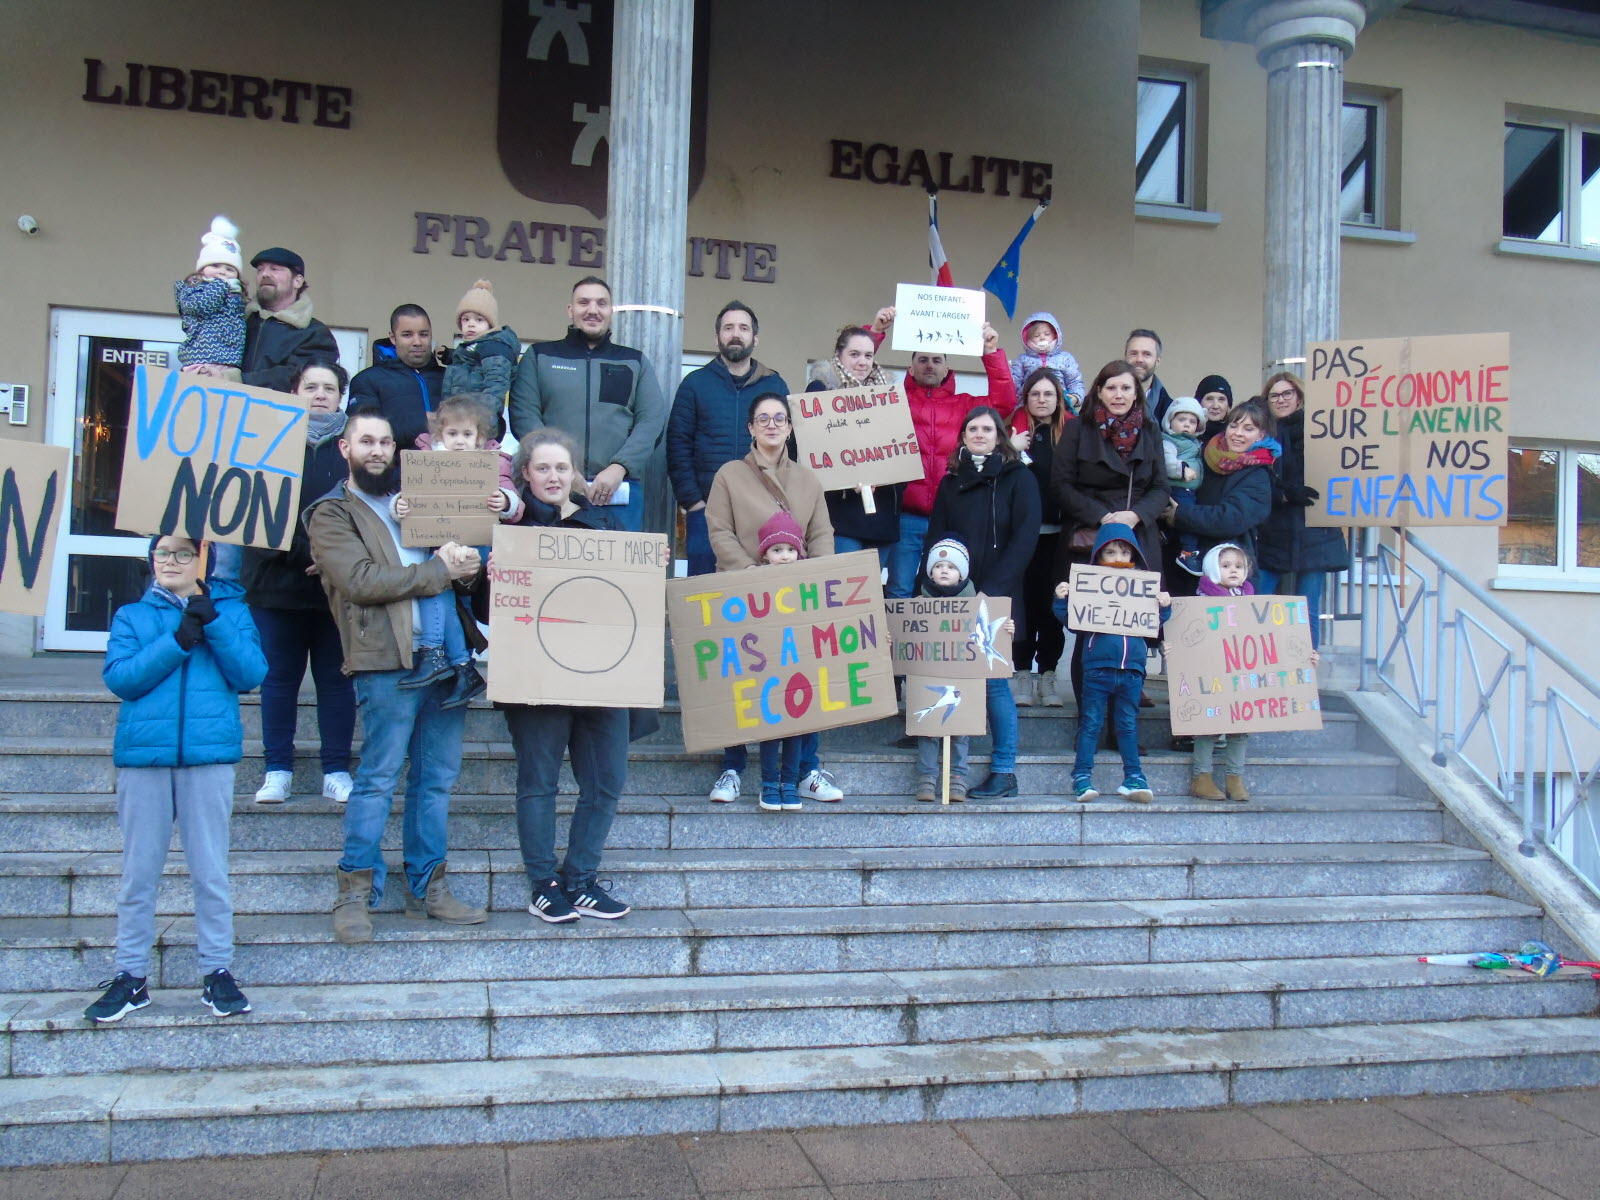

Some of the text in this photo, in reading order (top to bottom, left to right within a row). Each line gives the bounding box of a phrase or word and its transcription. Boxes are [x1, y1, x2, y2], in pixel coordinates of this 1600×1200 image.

[82, 57, 352, 129] LIBERTE
[830, 139, 1053, 200] EGALITE
[413, 212, 776, 283] FRATEITE
[917, 293, 933, 301] NOS
[911, 309, 970, 320] AVANT L'ARGENT
[102, 348, 168, 366] ENTREE
[1312, 346, 1368, 381] PAS
[800, 385, 899, 418] LA QUALITÉ
[136, 365, 305, 478] VOTEZ
[856, 418, 870, 428] que
[1311, 408, 1367, 439] SUR
[810, 433, 920, 469] LA QUANTITÉ
[1341, 440, 1490, 470] DE NOS
[160, 457, 292, 549] NON
[1327, 473, 1506, 521] ENFANTS
[538, 533, 664, 568] BUDGET MAIRIE
[491, 568, 532, 587] NOTRE
[1076, 572, 1157, 598] ECOLE
[494, 593, 530, 608] ECOLE
[686, 576, 871, 626] TOUCHEZ
[885, 600, 969, 615] NE TOUCHEZ
[1206, 601, 1308, 630] JE VOTE
[903, 619, 972, 632] PAS AUX
[695, 614, 877, 681] PAS A MON
[1222, 632, 1278, 673] NON
[733, 661, 872, 729] ECOLE
[1198, 676, 1223, 694] LA
[1232, 667, 1312, 692] FERMETURE
[1206, 706, 1222, 717] DE
[1229, 697, 1288, 724] NOTRE
